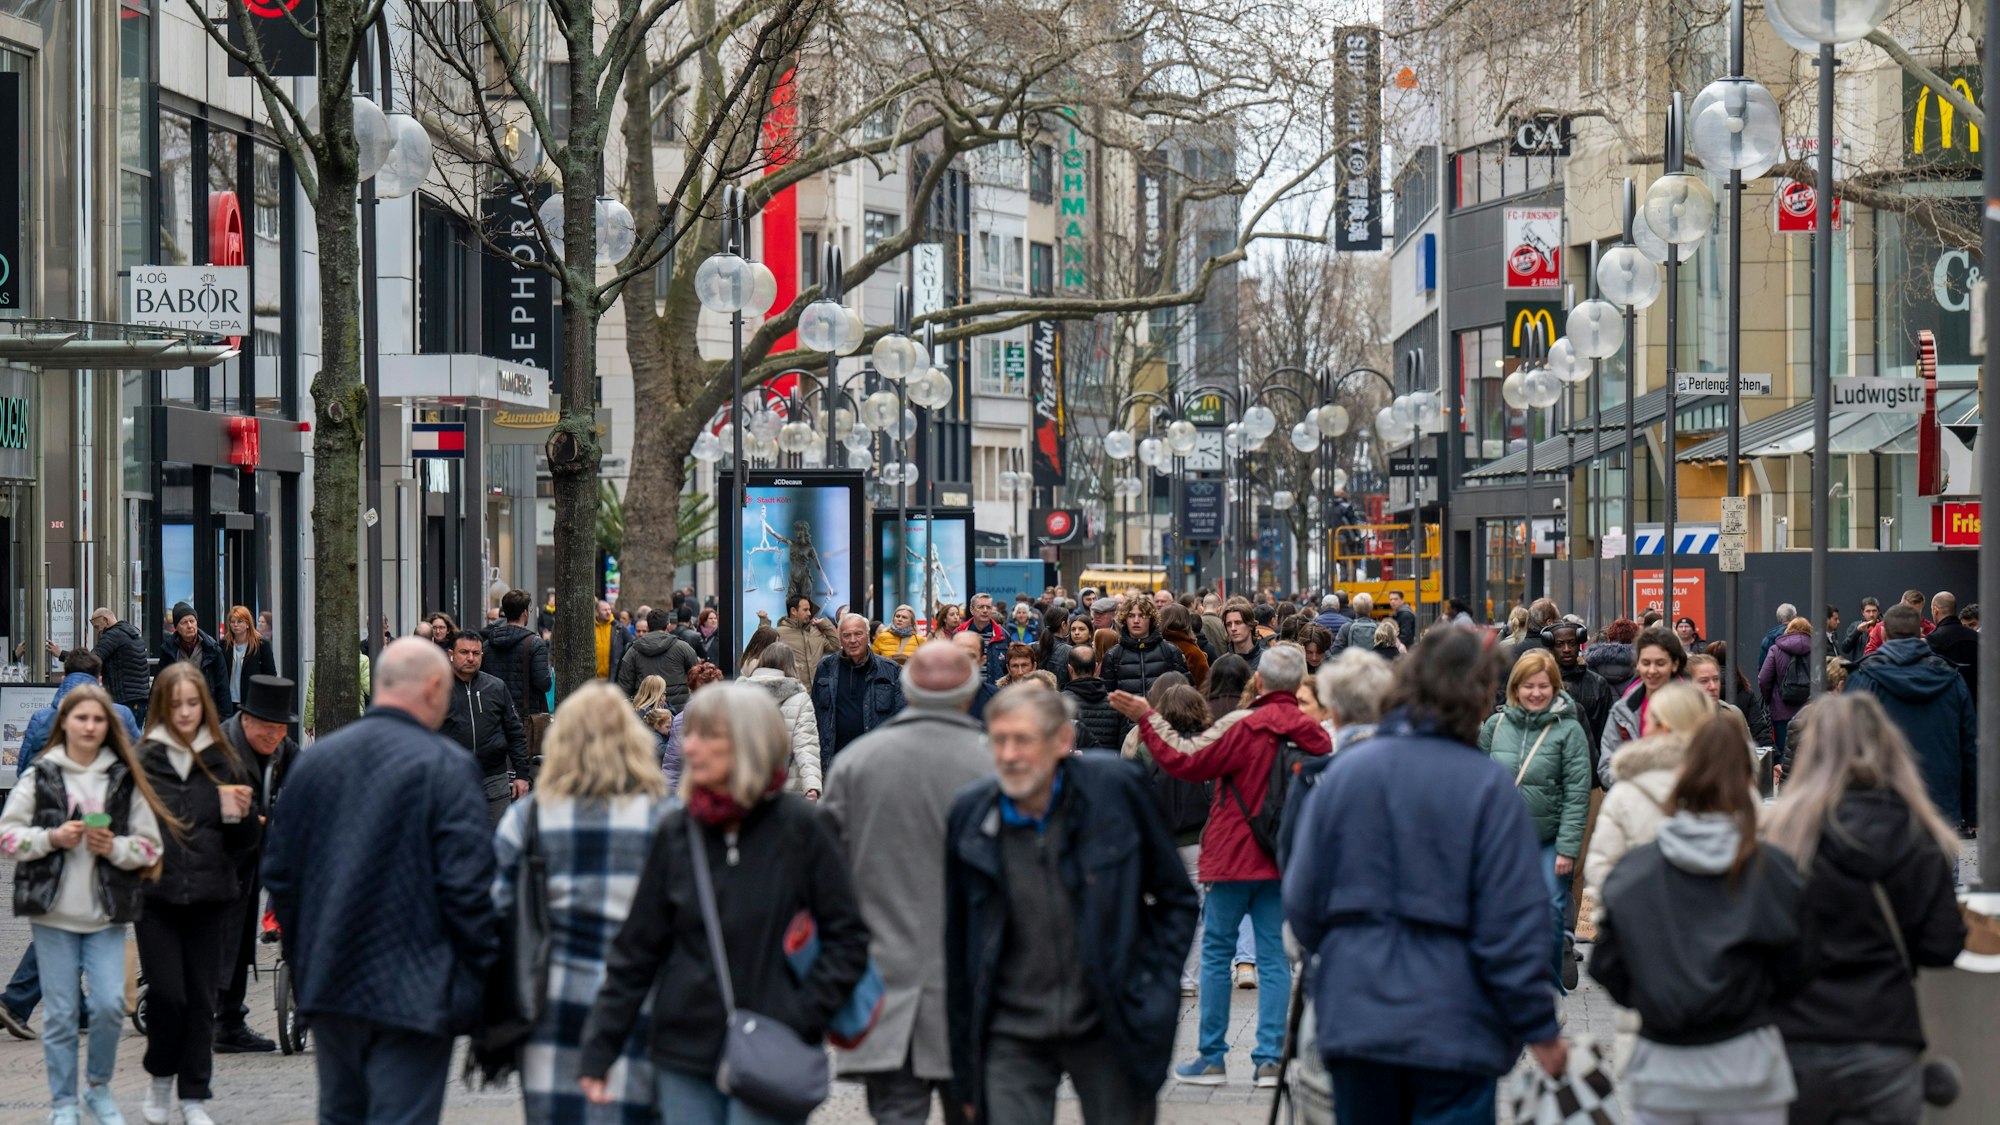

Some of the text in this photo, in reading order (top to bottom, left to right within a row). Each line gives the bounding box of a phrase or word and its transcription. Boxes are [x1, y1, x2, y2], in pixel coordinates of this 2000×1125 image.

[1517, 123, 1563, 150] C&A
[1934, 250, 1984, 312] C&
[136, 287, 241, 316] BABOR
[209, 320, 241, 330] SPA
[1833, 383, 1925, 409] Ludwigstr.
[773, 478, 803, 486] JCDecaux
[1952, 513, 1982, 533] Fris
[1641, 587, 1657, 596] NEU
[1673, 587, 1688, 596] ÖLN
